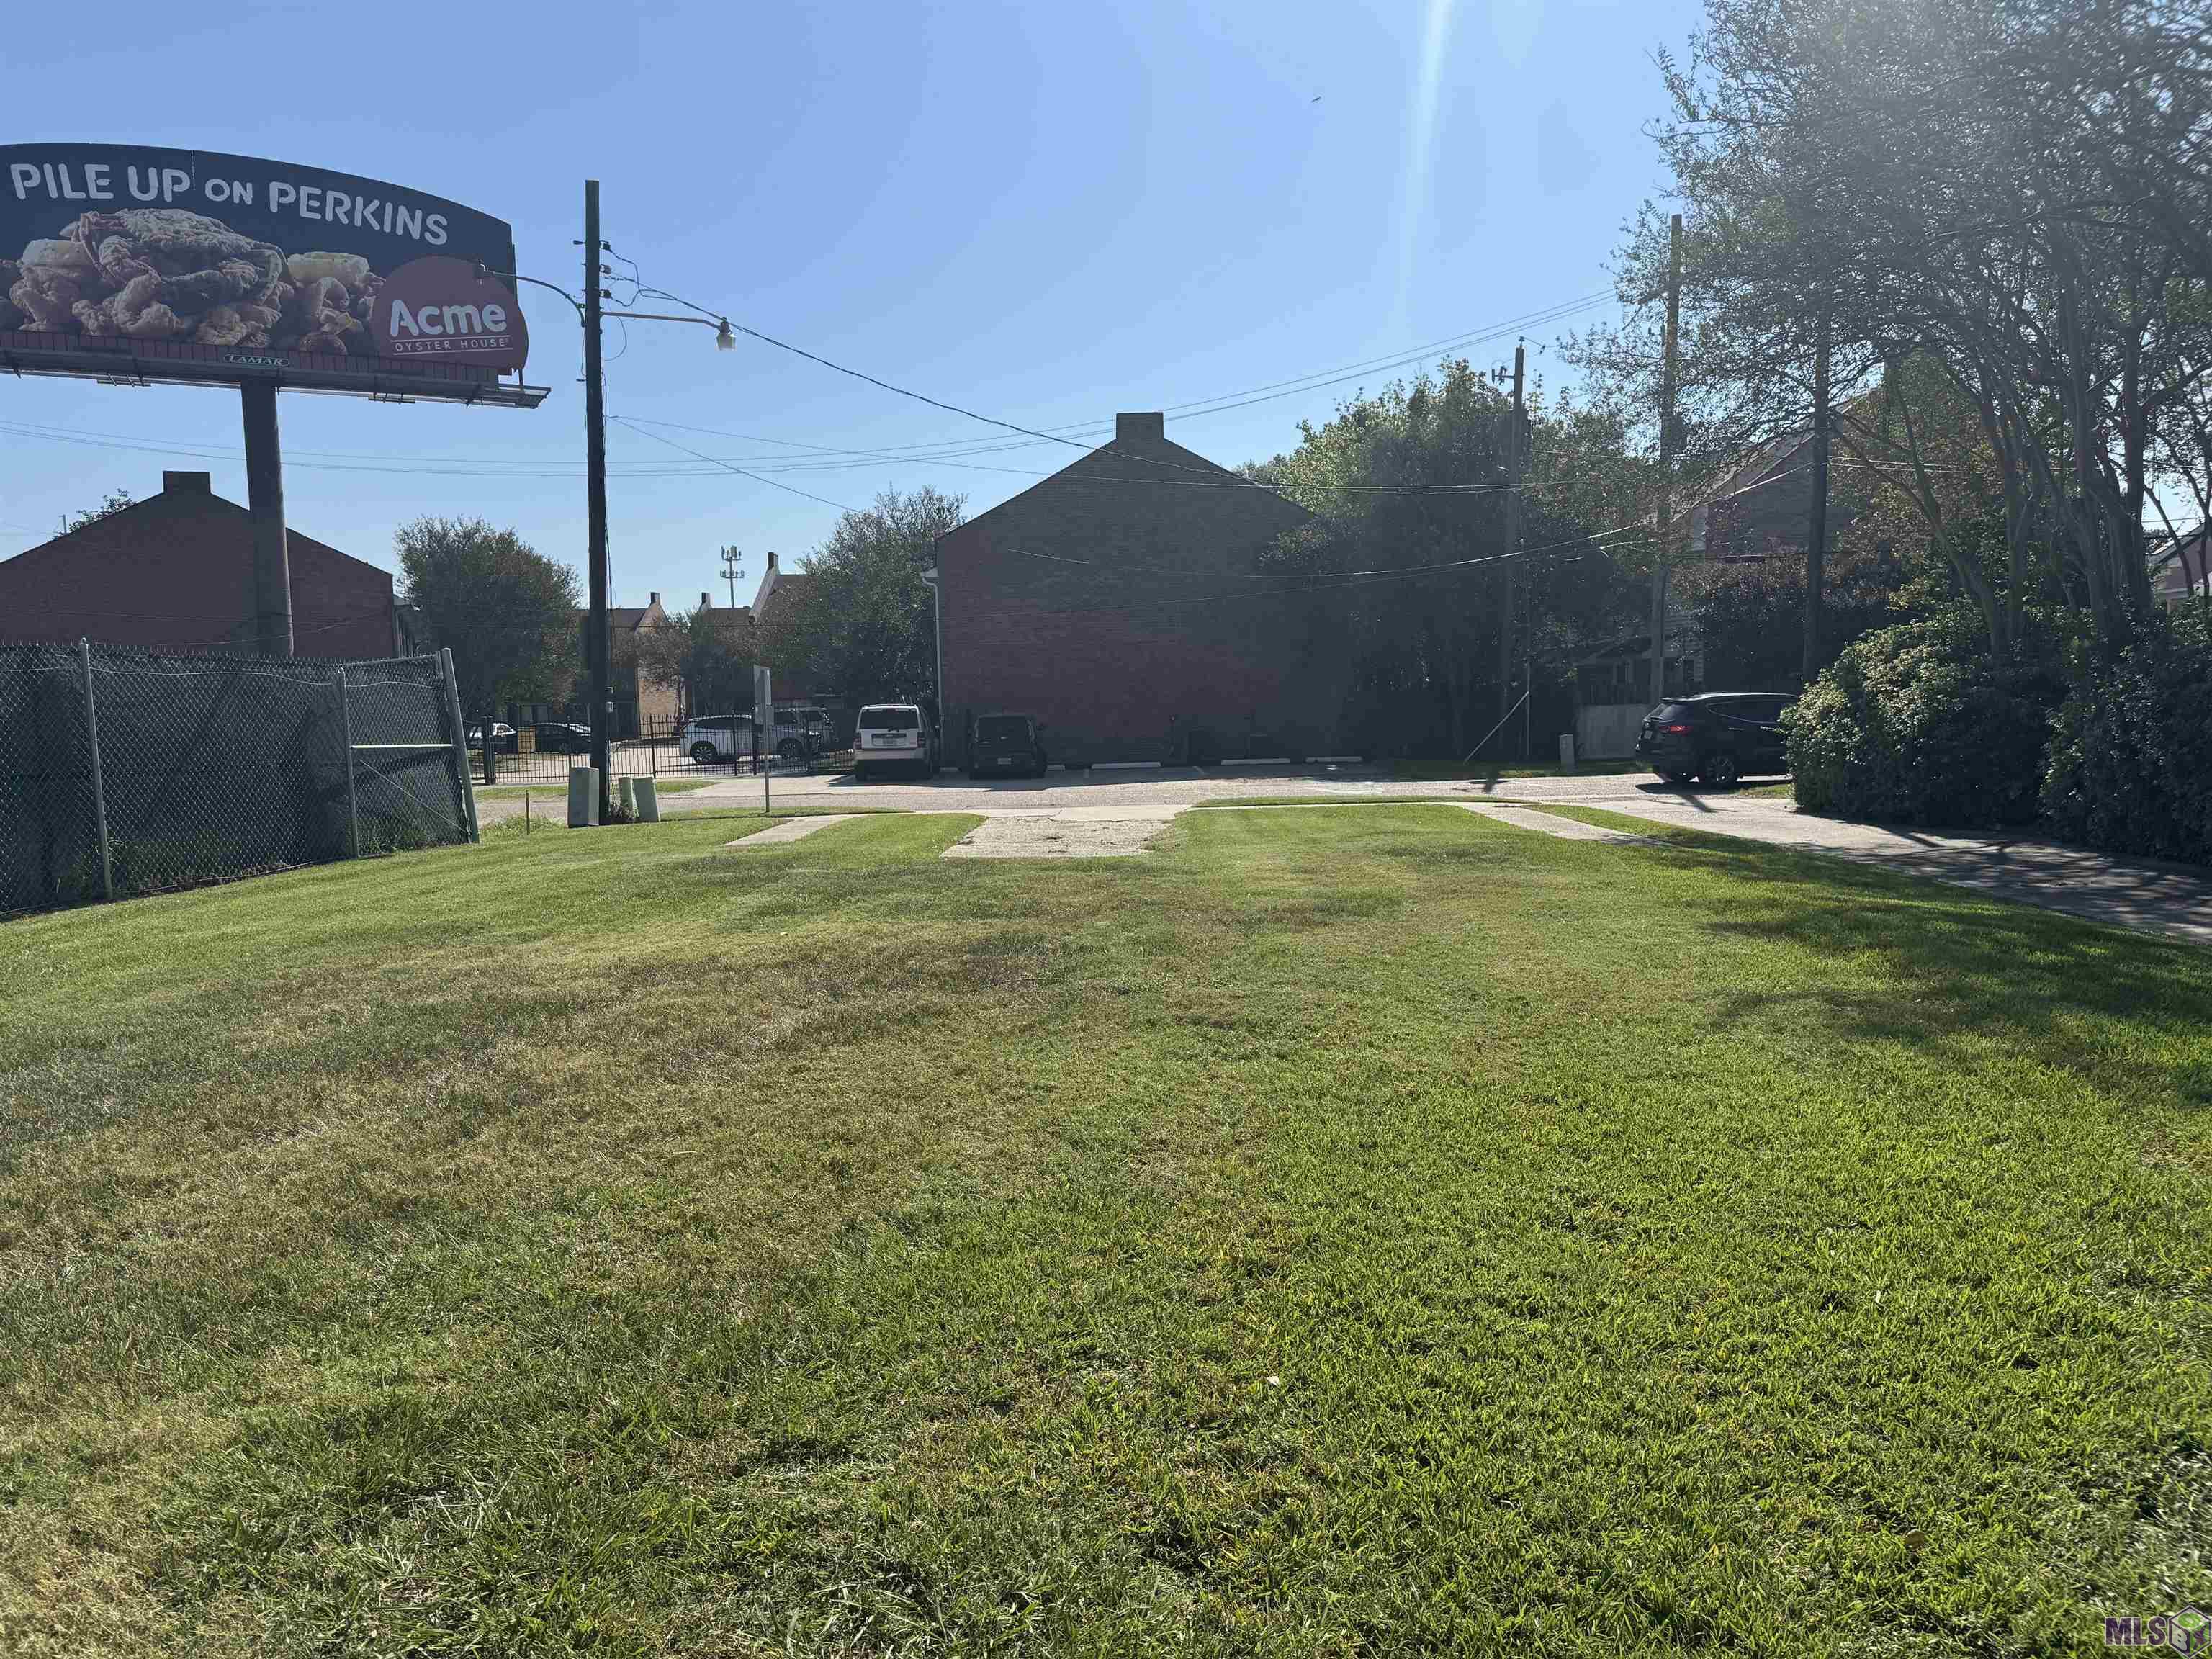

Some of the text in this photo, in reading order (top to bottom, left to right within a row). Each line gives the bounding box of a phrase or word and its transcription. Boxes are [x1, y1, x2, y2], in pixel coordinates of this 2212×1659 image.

[10, 163, 448, 246] PILE UP ON PERKINS
[390, 299, 507, 337] Acme
[395, 338, 506, 352] OYSTER HOUSE
[229, 356, 283, 365] LAMAR
